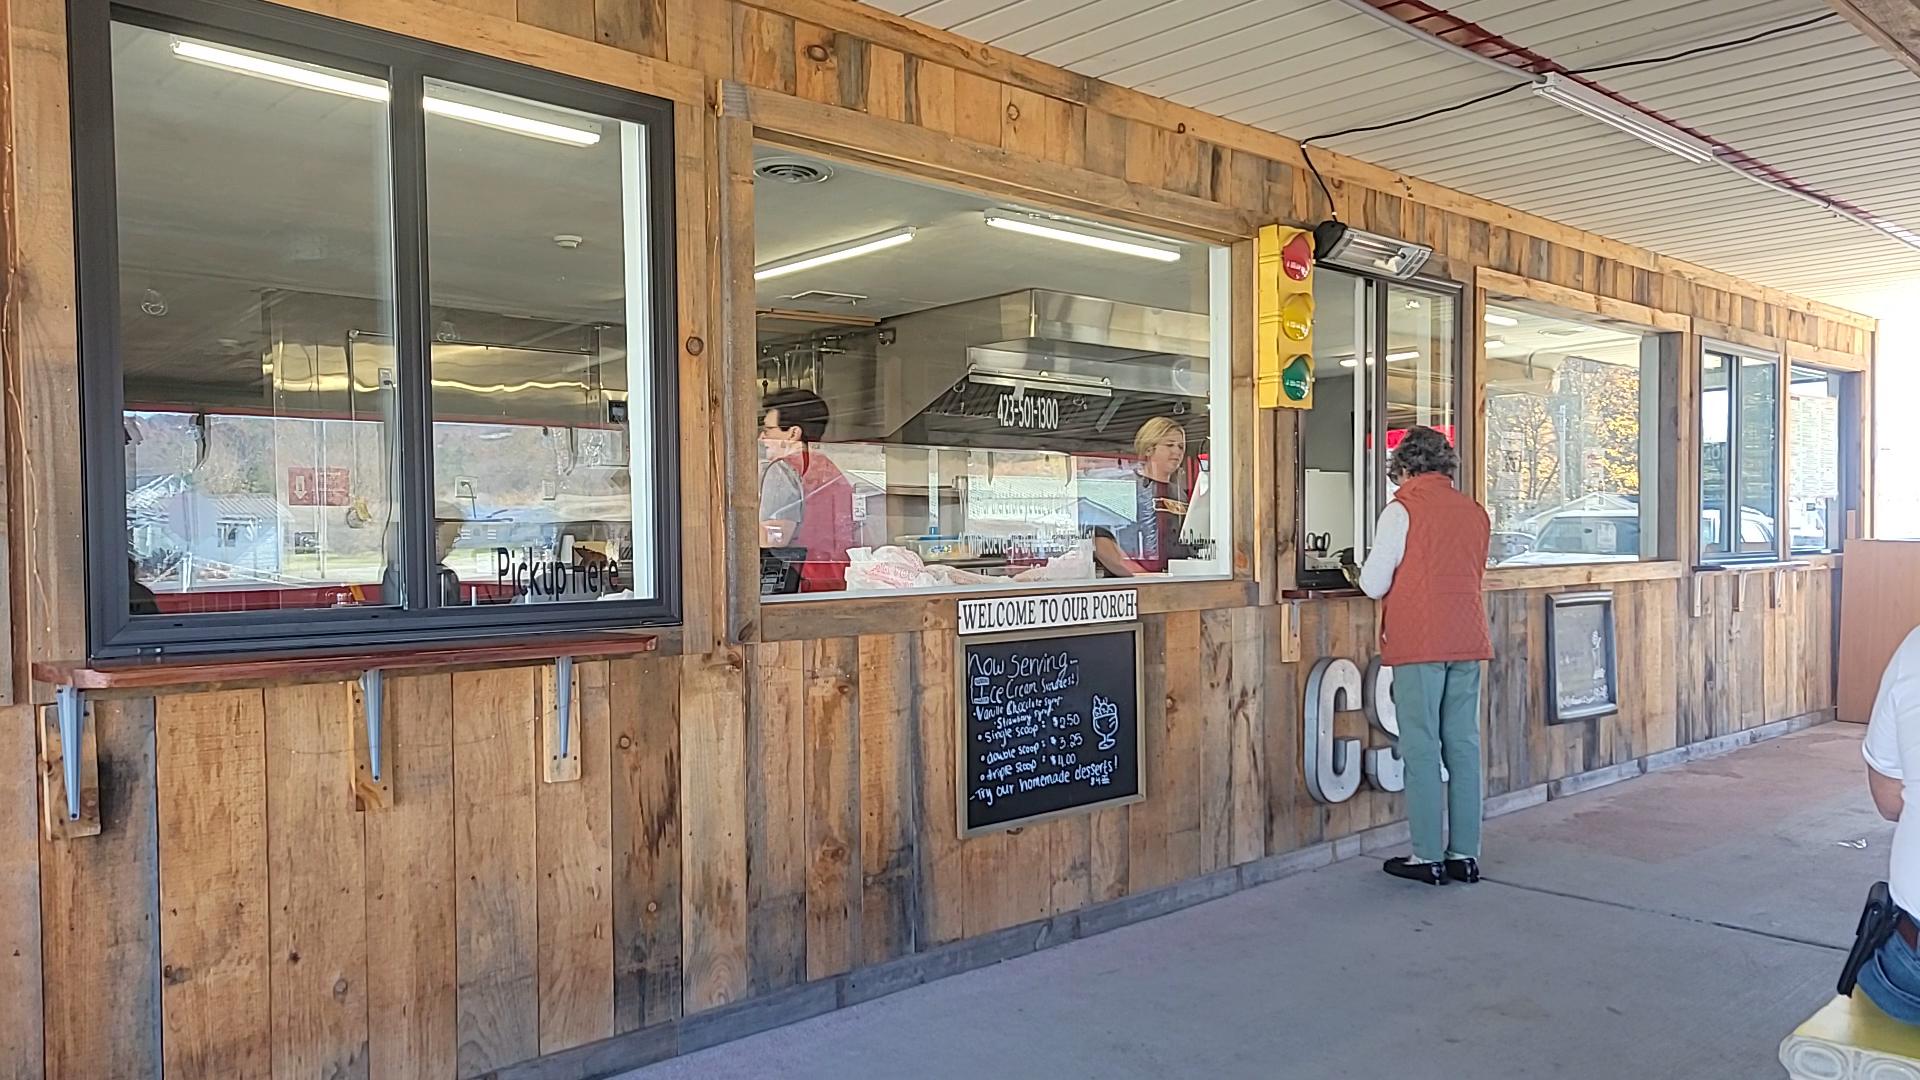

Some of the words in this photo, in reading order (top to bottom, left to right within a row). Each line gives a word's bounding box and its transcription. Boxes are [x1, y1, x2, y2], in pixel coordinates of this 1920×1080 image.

[997, 393, 1059, 430] 423-501-1300
[497, 546, 567, 601] Pickup
[572, 545, 619, 594] Here
[962, 600, 1037, 630] WELCOME
[1039, 598, 1059, 624] TO
[1061, 596, 1089, 622] OUR
[1092, 593, 1135, 620] PORCH
[973, 676, 1004, 704] Ice
[1006, 679, 1038, 699] Cream
[986, 748, 1016, 765] double
[1050, 732, 1084, 750] $3.25
[986, 764, 1013, 781] triple
[1050, 753, 1077, 767] $4.00
[995, 783, 1014, 797] our
[1018, 769, 1070, 793] homemade
[1074, 755, 1118, 781] desserts!
